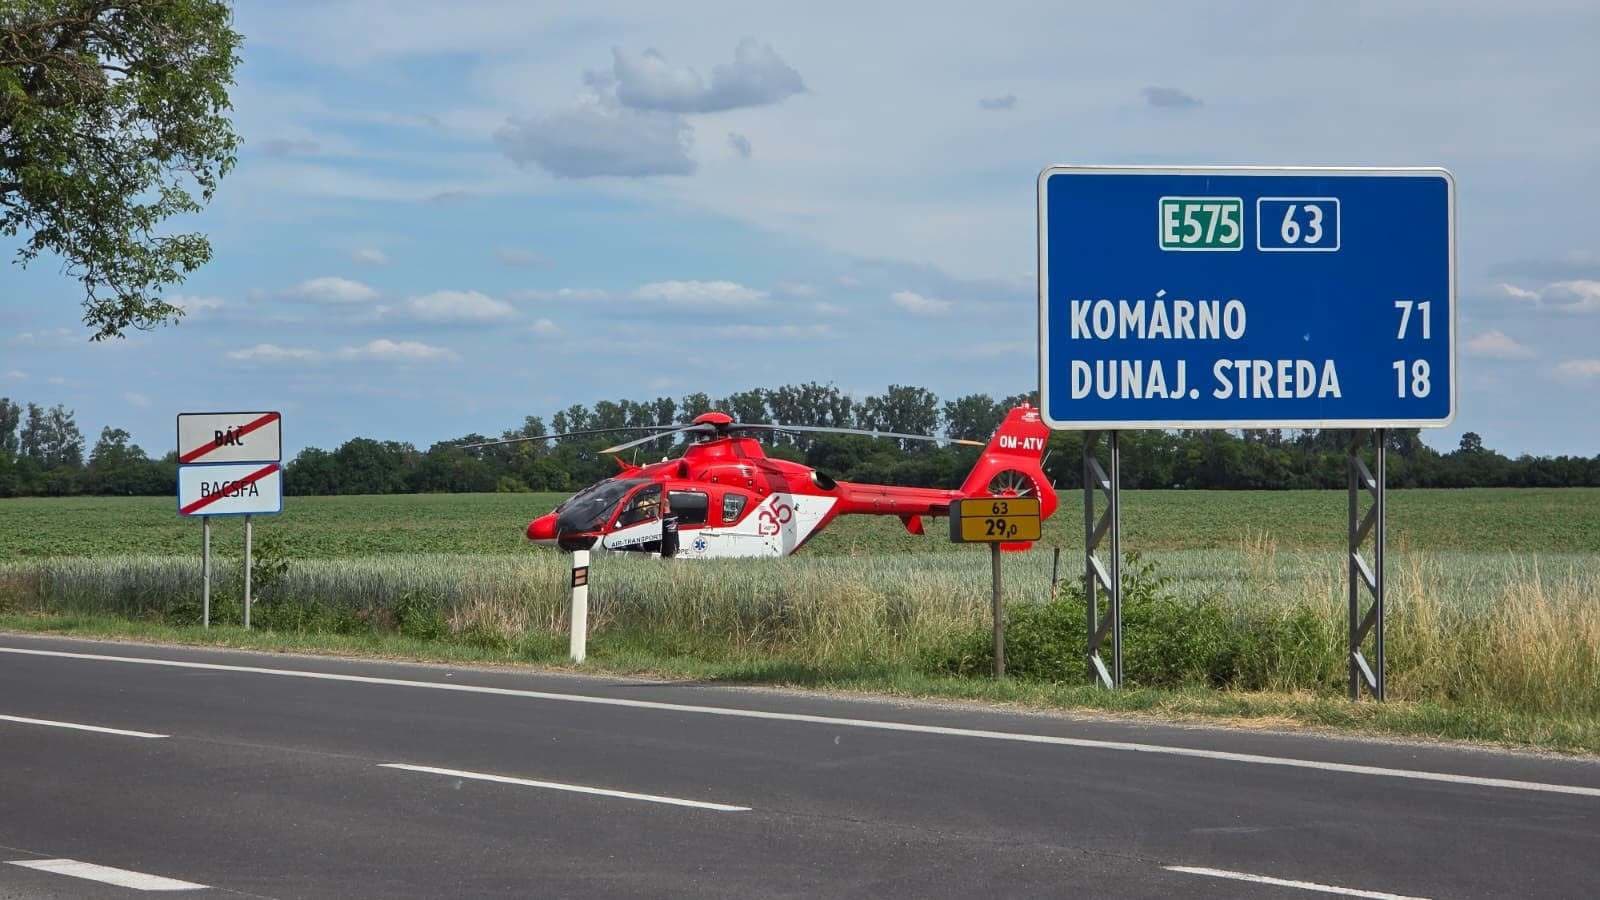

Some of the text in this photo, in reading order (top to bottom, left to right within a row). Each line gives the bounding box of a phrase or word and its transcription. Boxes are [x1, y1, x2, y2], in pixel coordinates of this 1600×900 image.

[1163, 204, 1323, 244] E575 63
[1071, 289, 1431, 340] KOMÁRNO 71
[1071, 358, 1431, 400] DUNAJ. STREDA 18
[214, 426, 244, 446] BÁČ
[999, 435, 1044, 450] OM-ATV
[201, 481, 259, 498] BACSFA
[992, 502, 1009, 515] 63
[985, 519, 1018, 538] 29,0
